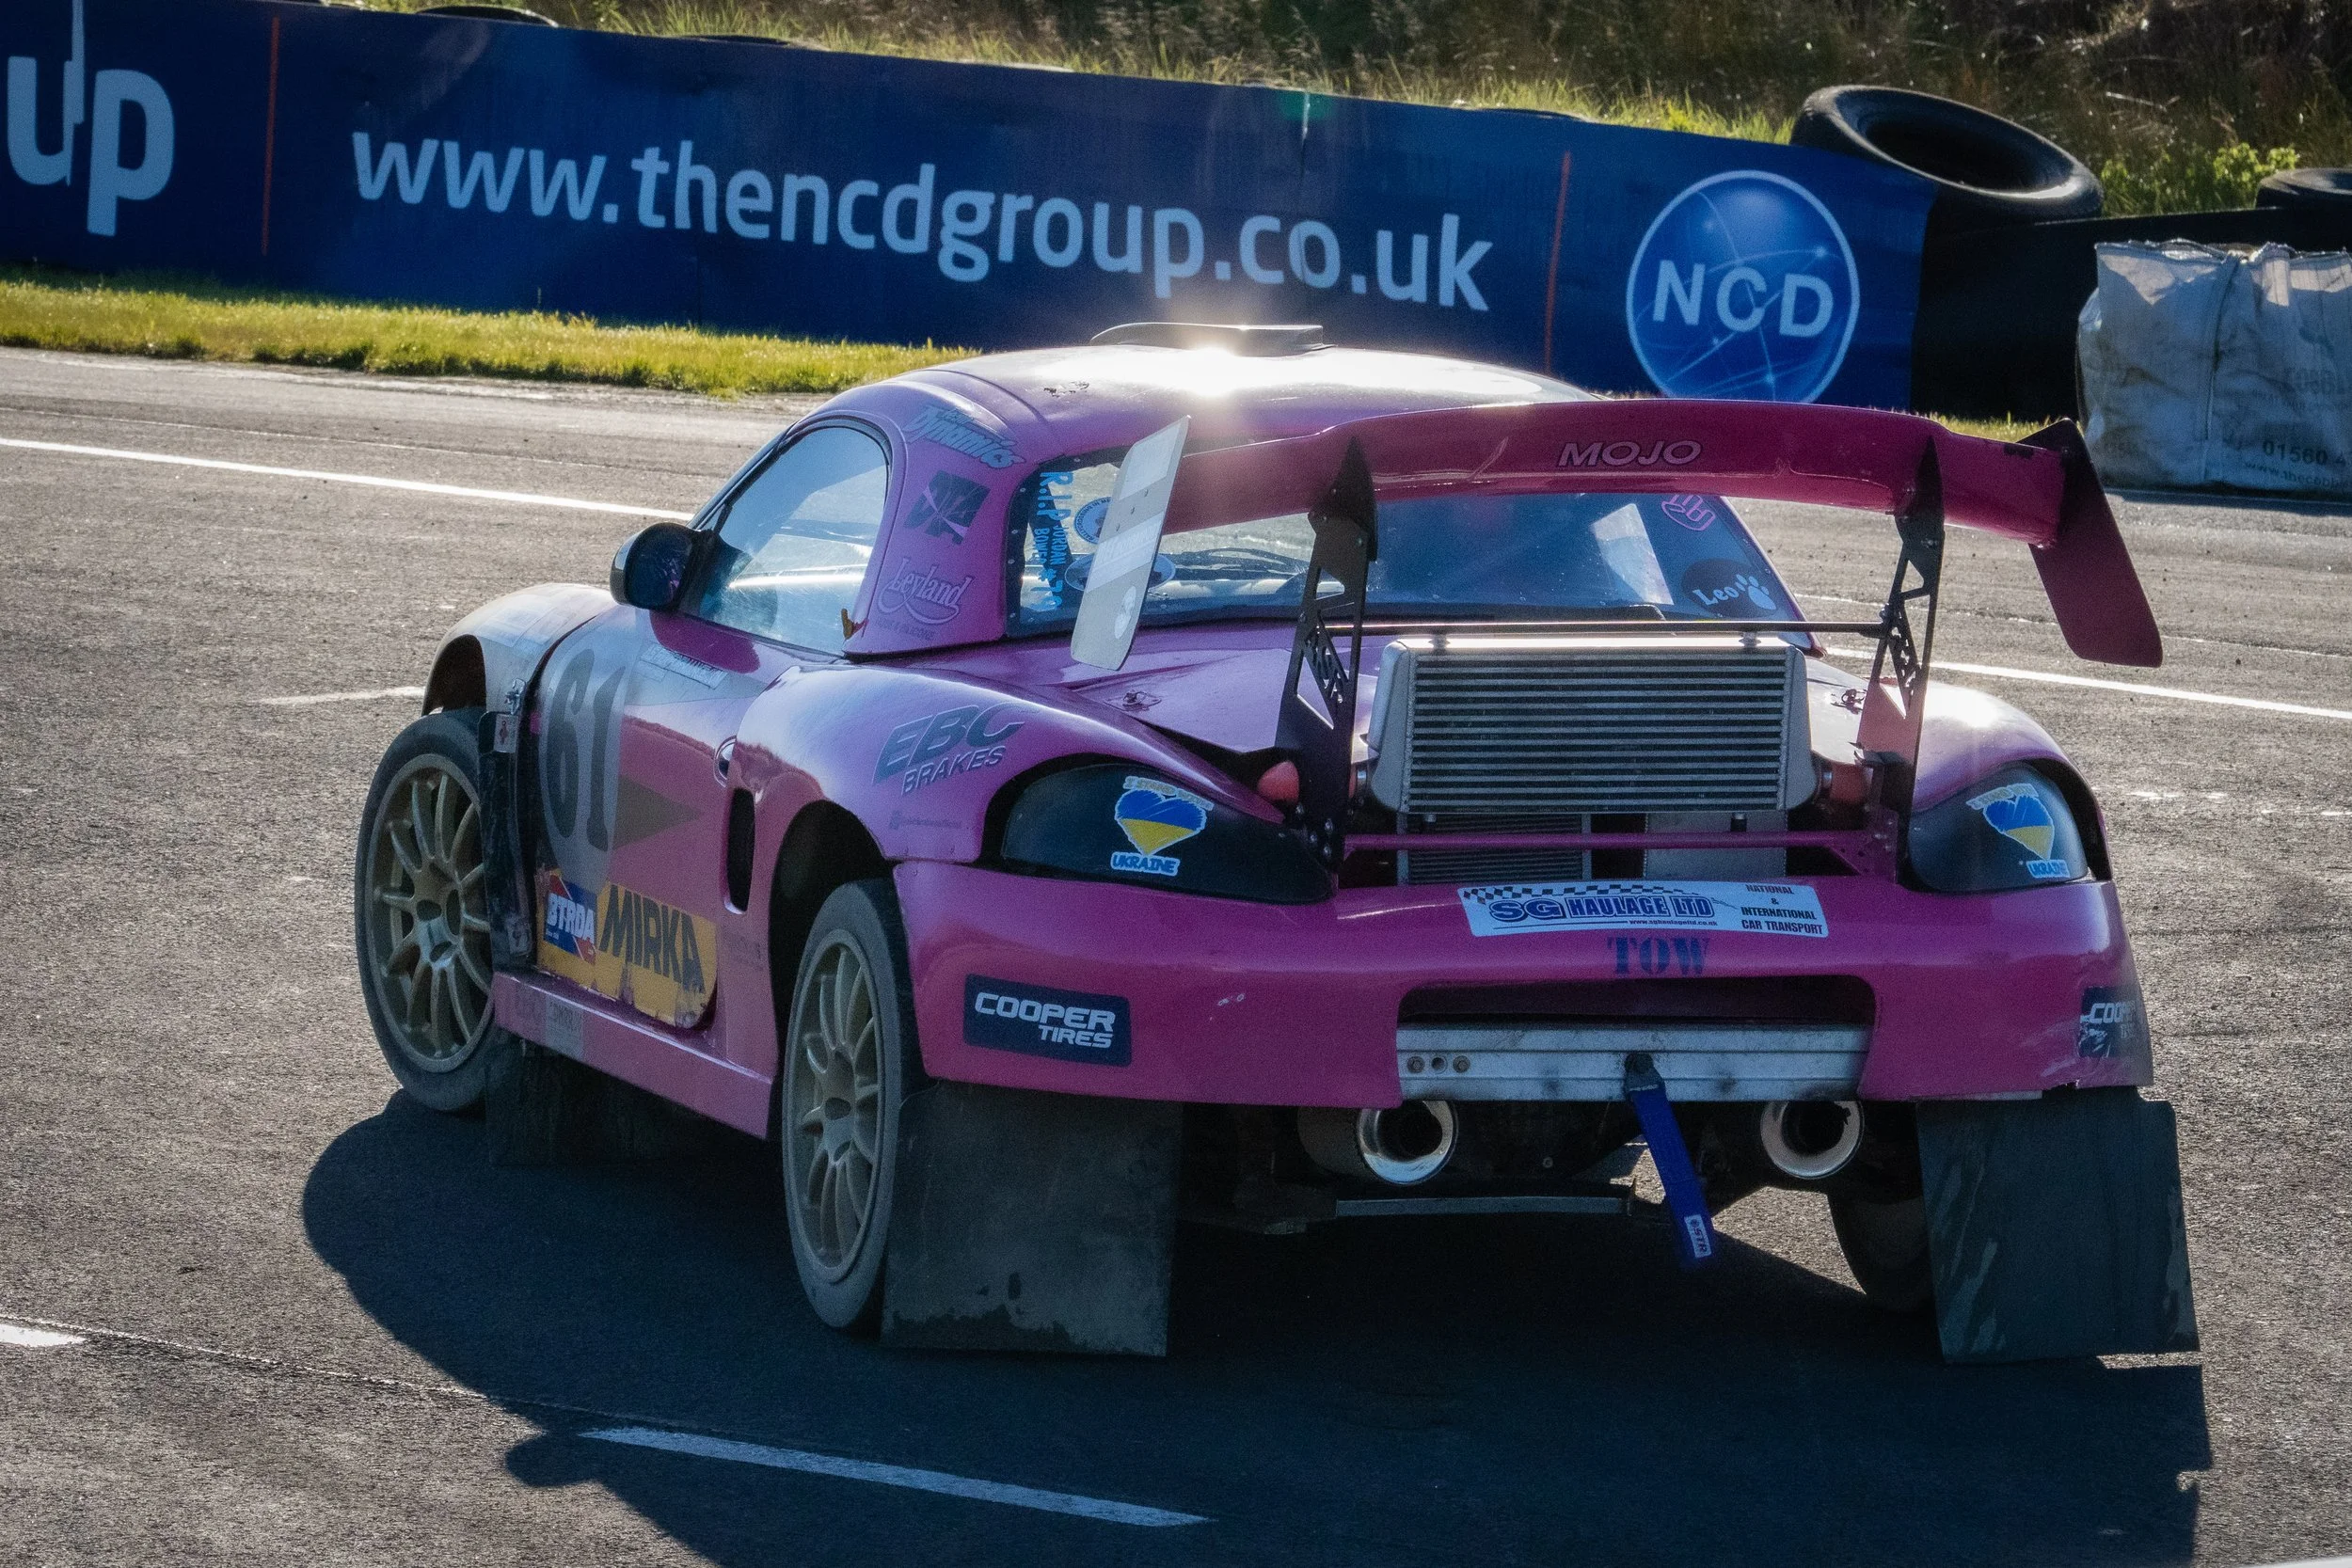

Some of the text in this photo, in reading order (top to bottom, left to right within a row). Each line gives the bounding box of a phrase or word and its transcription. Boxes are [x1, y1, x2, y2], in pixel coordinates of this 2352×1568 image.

[351, 130, 1494, 312] www.thencdgroup.co.uk
[1653, 259, 1835, 340] NCD
[1557, 439, 1704, 467] MOJO
[1050, 525, 1070, 565] JORDAN
[878, 557, 977, 625] Leyland
[1692, 585, 1740, 606] Leo
[871, 701, 1025, 785] EBC
[900, 745, 1007, 796] BRAKES
[1112, 853, 1178, 874] UKRAINE
[1488, 895, 1715, 923] SG HAULAGE LTD
[1744, 883, 1795, 895] NATIONAL
[1771, 896, 1780, 906] &
[547, 893, 596, 945] BTRDA
[1740, 906, 1818, 920] INTERNATIONAL
[1741, 919, 1823, 935] CAR TRANSPORT
[597, 884, 706, 994] MIRKA
[1607, 936, 1709, 976] TOW
[975, 991, 1117, 1033] COOPER
[1038, 1024, 1115, 1049] TIRES
